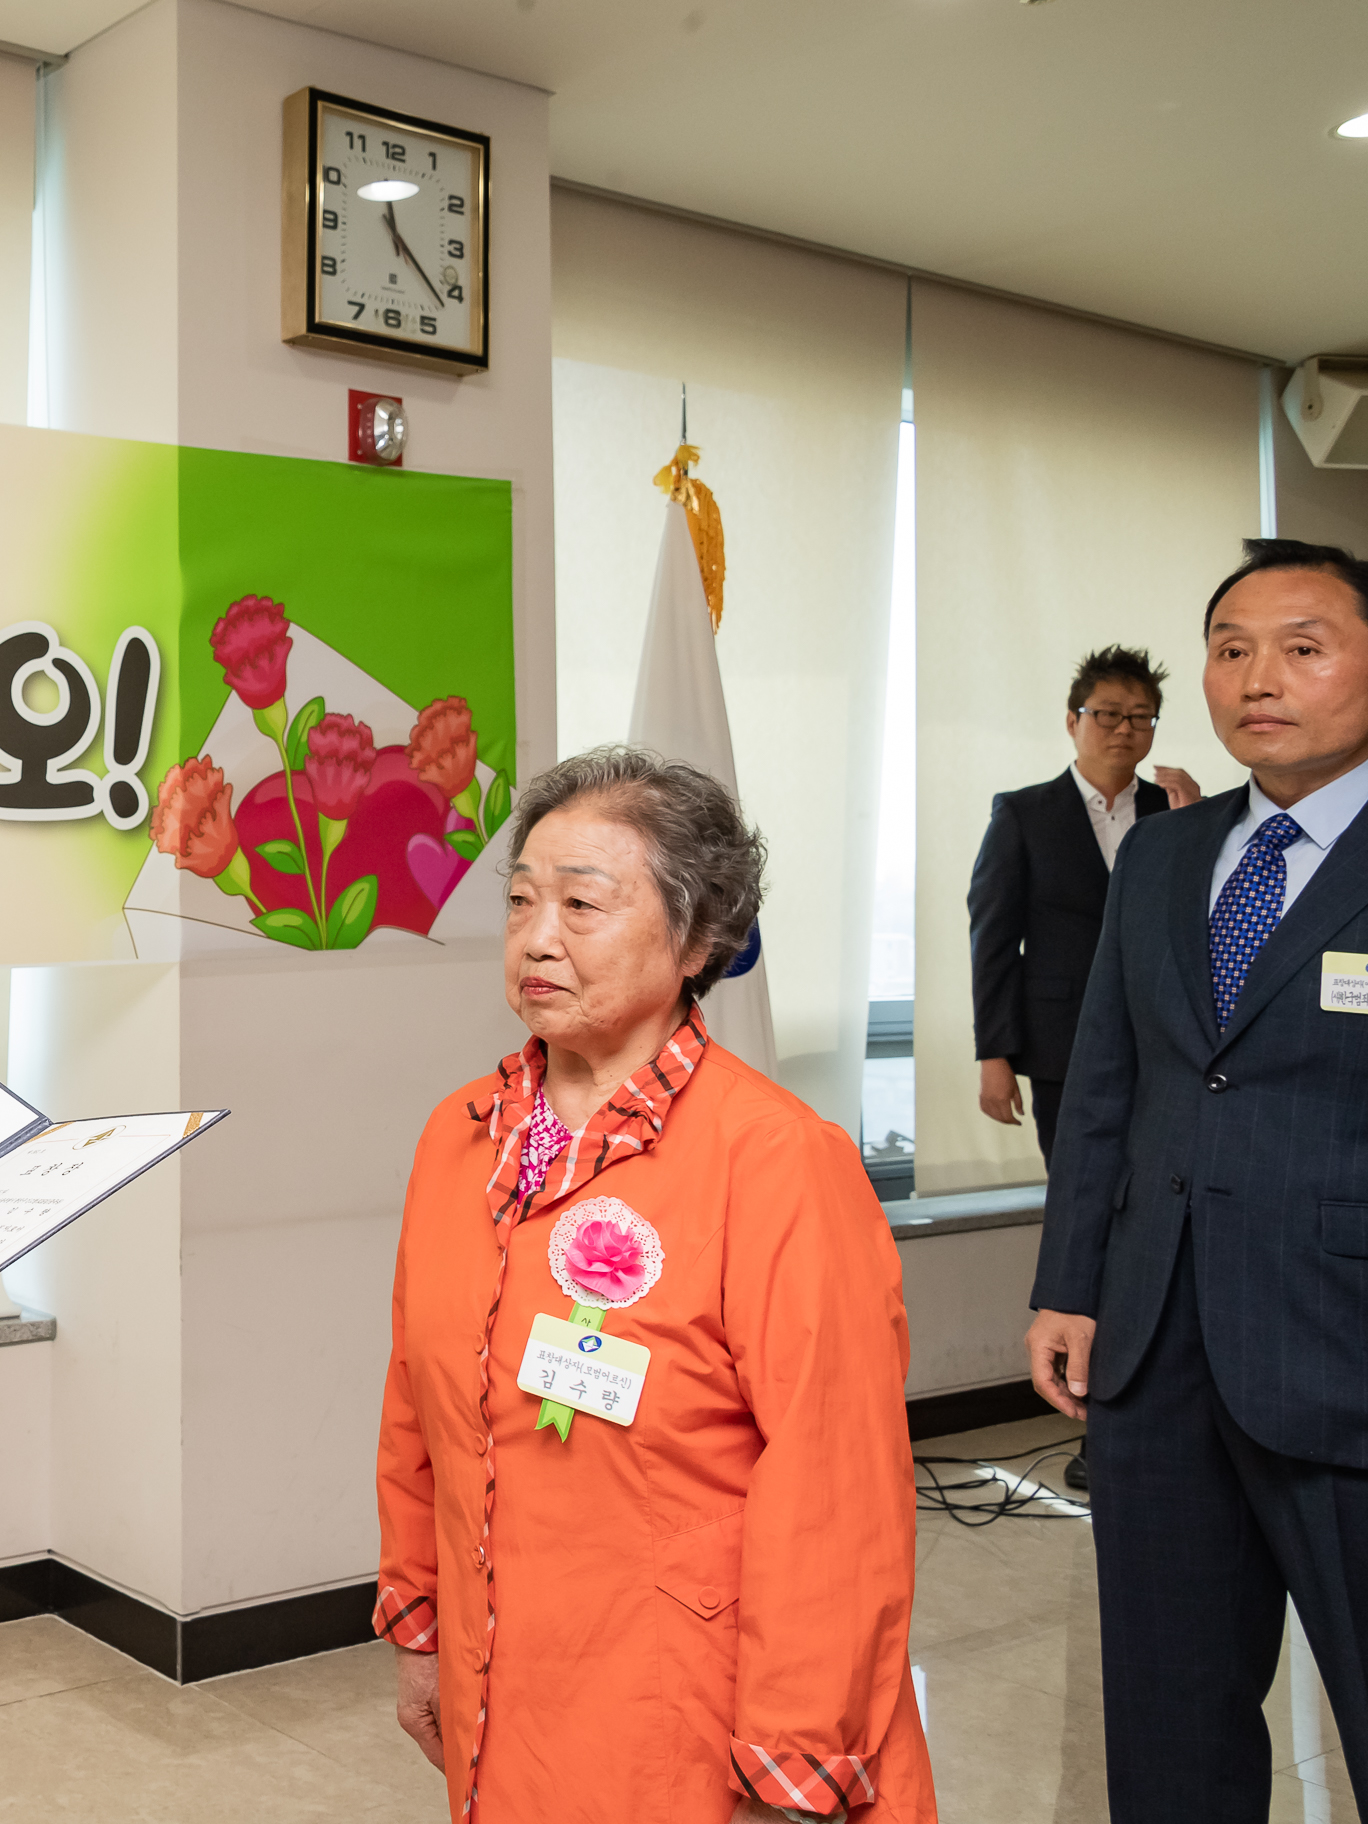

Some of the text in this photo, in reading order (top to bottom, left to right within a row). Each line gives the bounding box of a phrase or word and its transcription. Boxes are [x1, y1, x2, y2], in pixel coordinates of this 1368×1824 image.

[345, 131, 366, 153] 11
[381, 140, 406, 163] 12
[427, 151, 437, 171] 1
[447, 194, 465, 215] 2
[322, 209, 338, 230] 9
[447, 239, 464, 260] 3
[321, 255, 337, 276] 8
[447, 285, 464, 304] 4
[347, 300, 366, 321] 7
[383, 308, 402, 329] 6
[419, 315, 437, 336] 5
